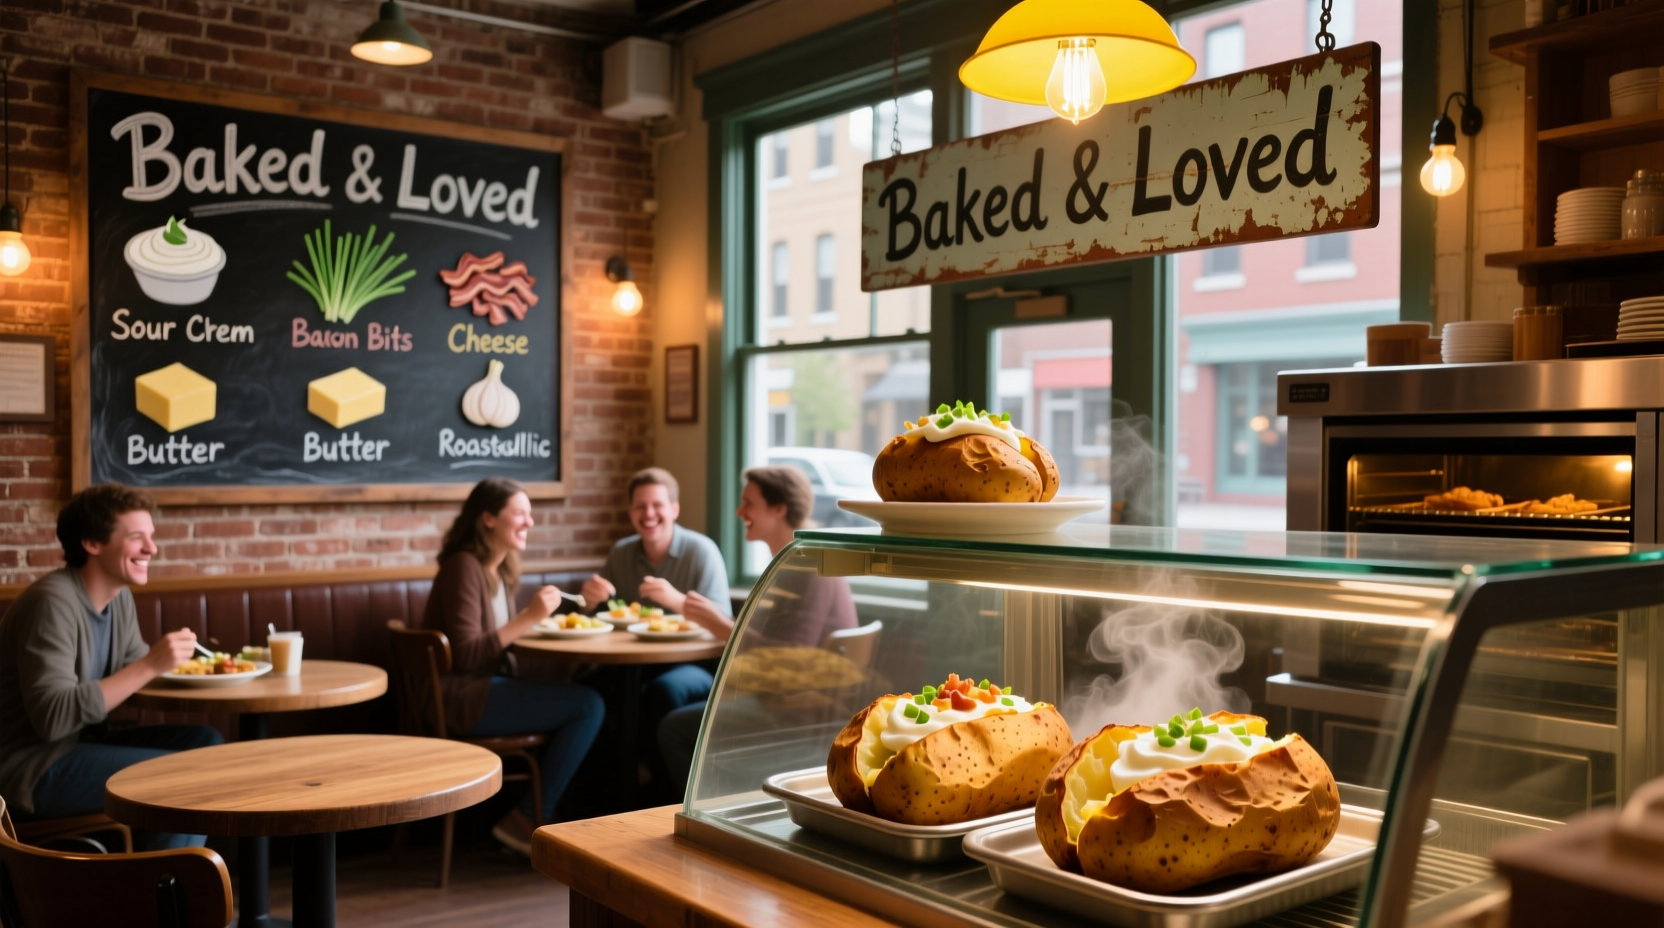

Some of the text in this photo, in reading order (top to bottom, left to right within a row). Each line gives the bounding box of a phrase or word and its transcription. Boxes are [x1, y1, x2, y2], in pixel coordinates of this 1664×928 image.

[111, 111, 540, 228] Baked & Loved
[879, 84, 1338, 262] Baked & Loved
[110, 307, 177, 341] Sour
[367, 321, 414, 353] Bits
[447, 322, 530, 356] Cheese
[127, 434, 225, 466] Butter
[303, 431, 391, 463] Butter
